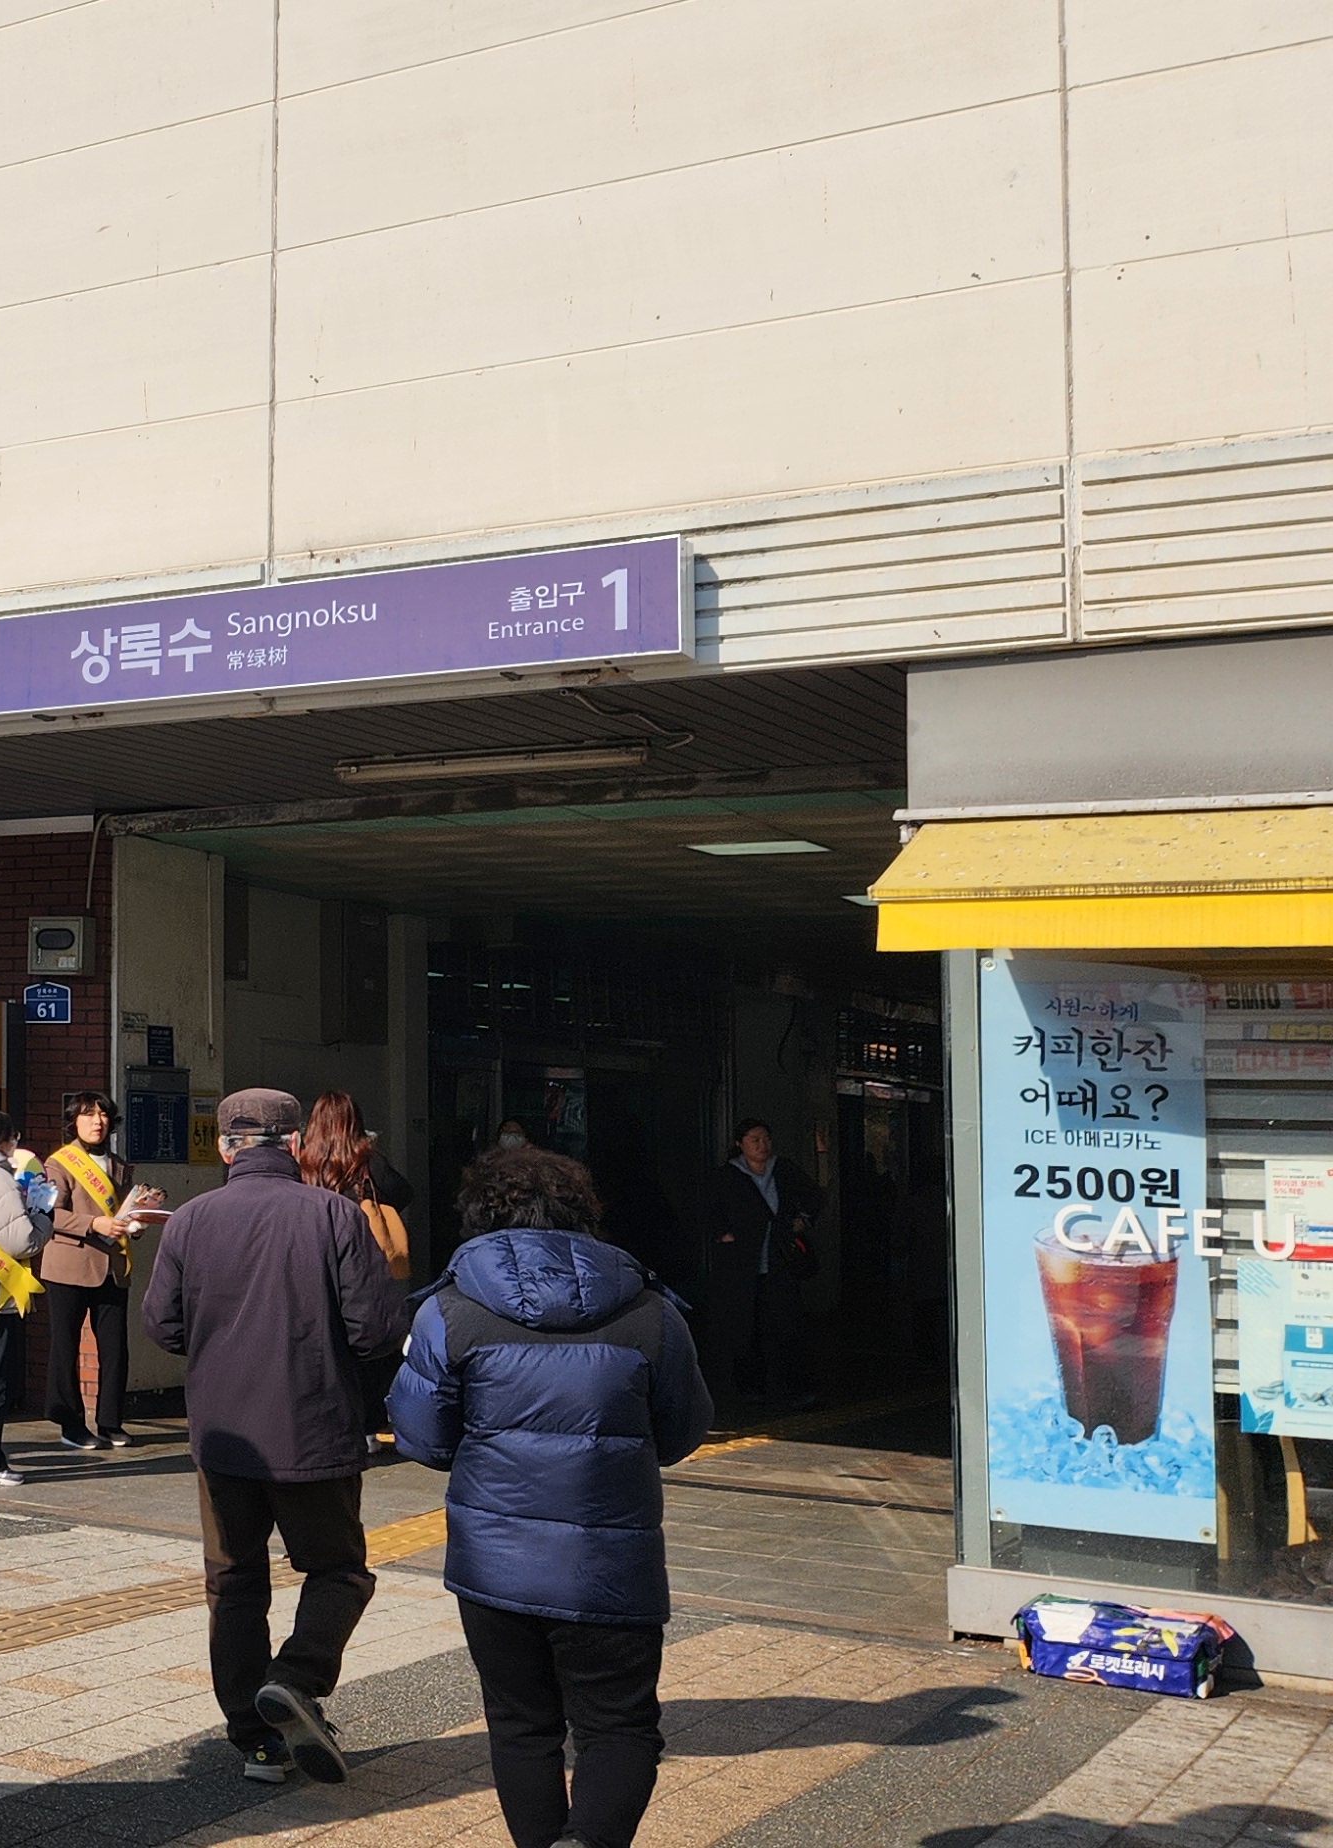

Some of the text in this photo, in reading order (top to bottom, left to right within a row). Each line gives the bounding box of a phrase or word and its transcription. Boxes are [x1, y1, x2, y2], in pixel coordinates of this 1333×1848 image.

[507, 581, 586, 612] 출입구
[600, 567, 630, 630] 1
[226, 599, 378, 641] Sangnoksu
[487, 615, 586, 640] Entrance
[70, 617, 212, 684] 상록수
[226, 645, 288, 671] 常绿树
[37, 1002, 56, 1018] 61
[1012, 1026, 1174, 1073] 커피한잔
[1020, 1079, 1169, 1122] 어때요?
[1024, 1129, 1162, 1150] ICE 아메리카노
[1013, 1164, 1181, 1209] 2500원
[1053, 1203, 1223, 1258] CAFE
[1089, 1654, 1165, 1681] 로켓프레시
